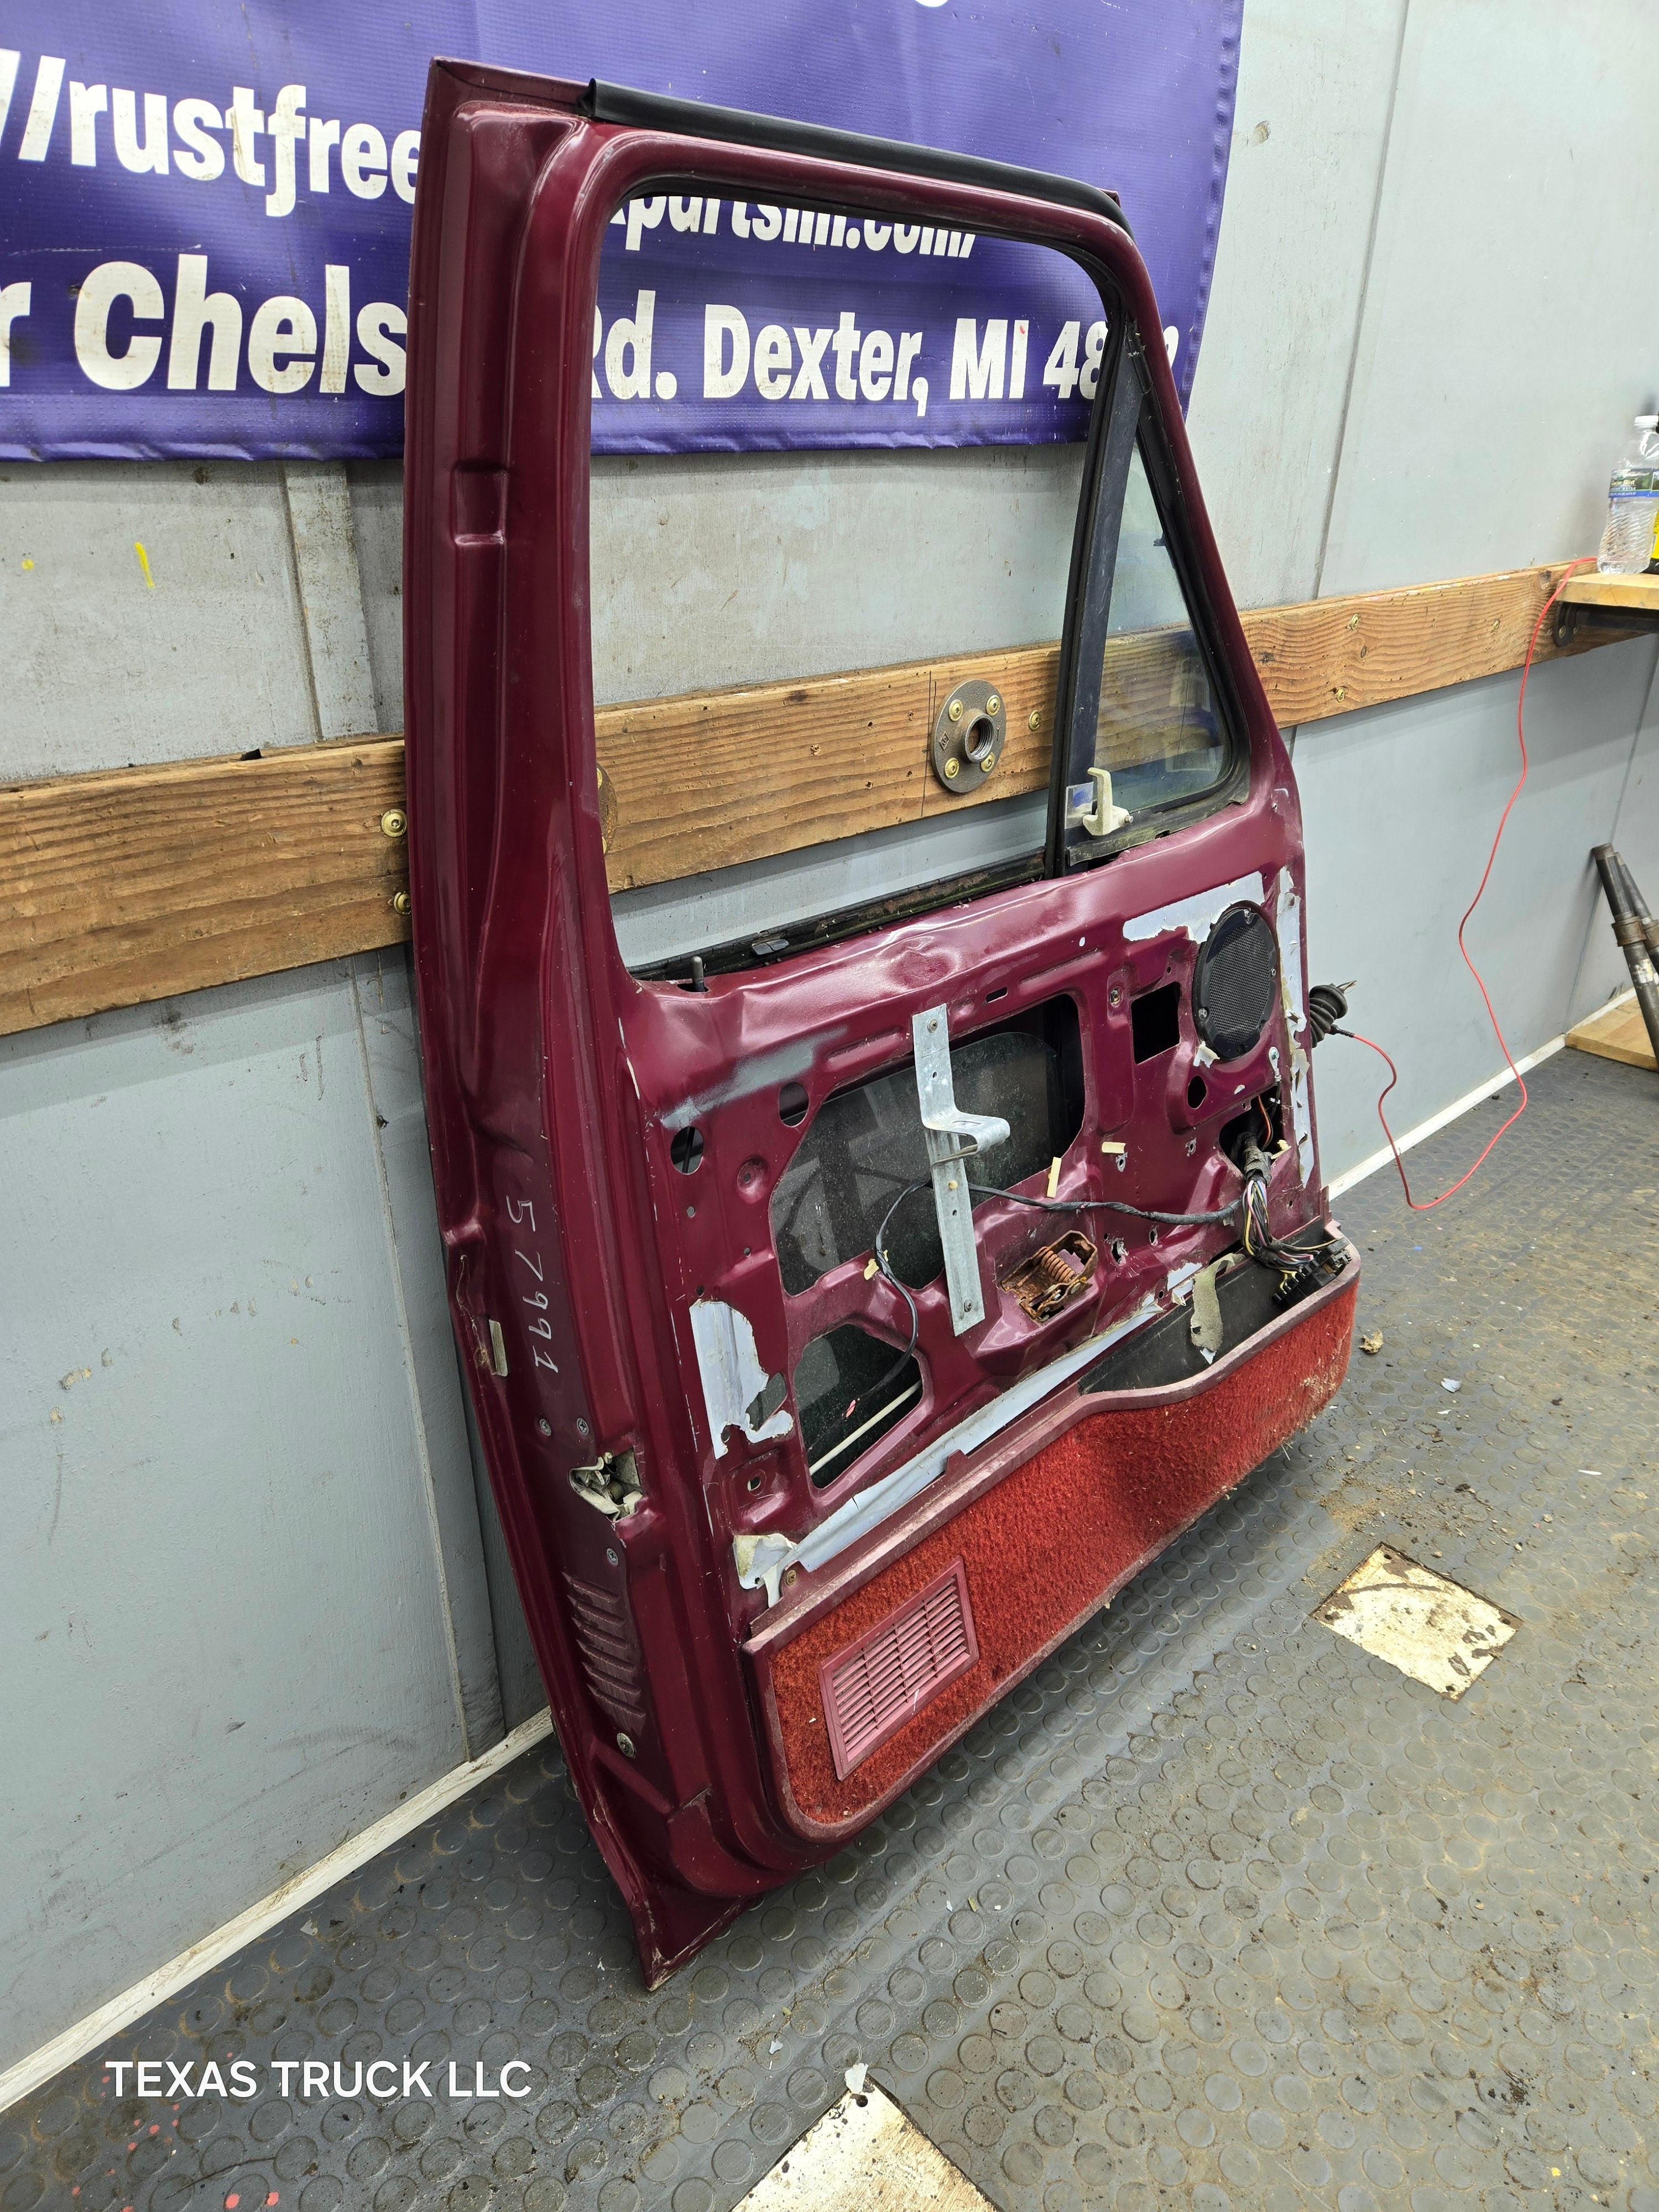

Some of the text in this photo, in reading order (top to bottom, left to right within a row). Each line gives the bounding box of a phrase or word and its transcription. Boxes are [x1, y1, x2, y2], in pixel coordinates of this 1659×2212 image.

[591, 289, 677, 400] d.
[703, 305, 927, 417] Dexter,
[950, 318, 1028, 400] MI
[506, 1194, 559, 1373] 57991
